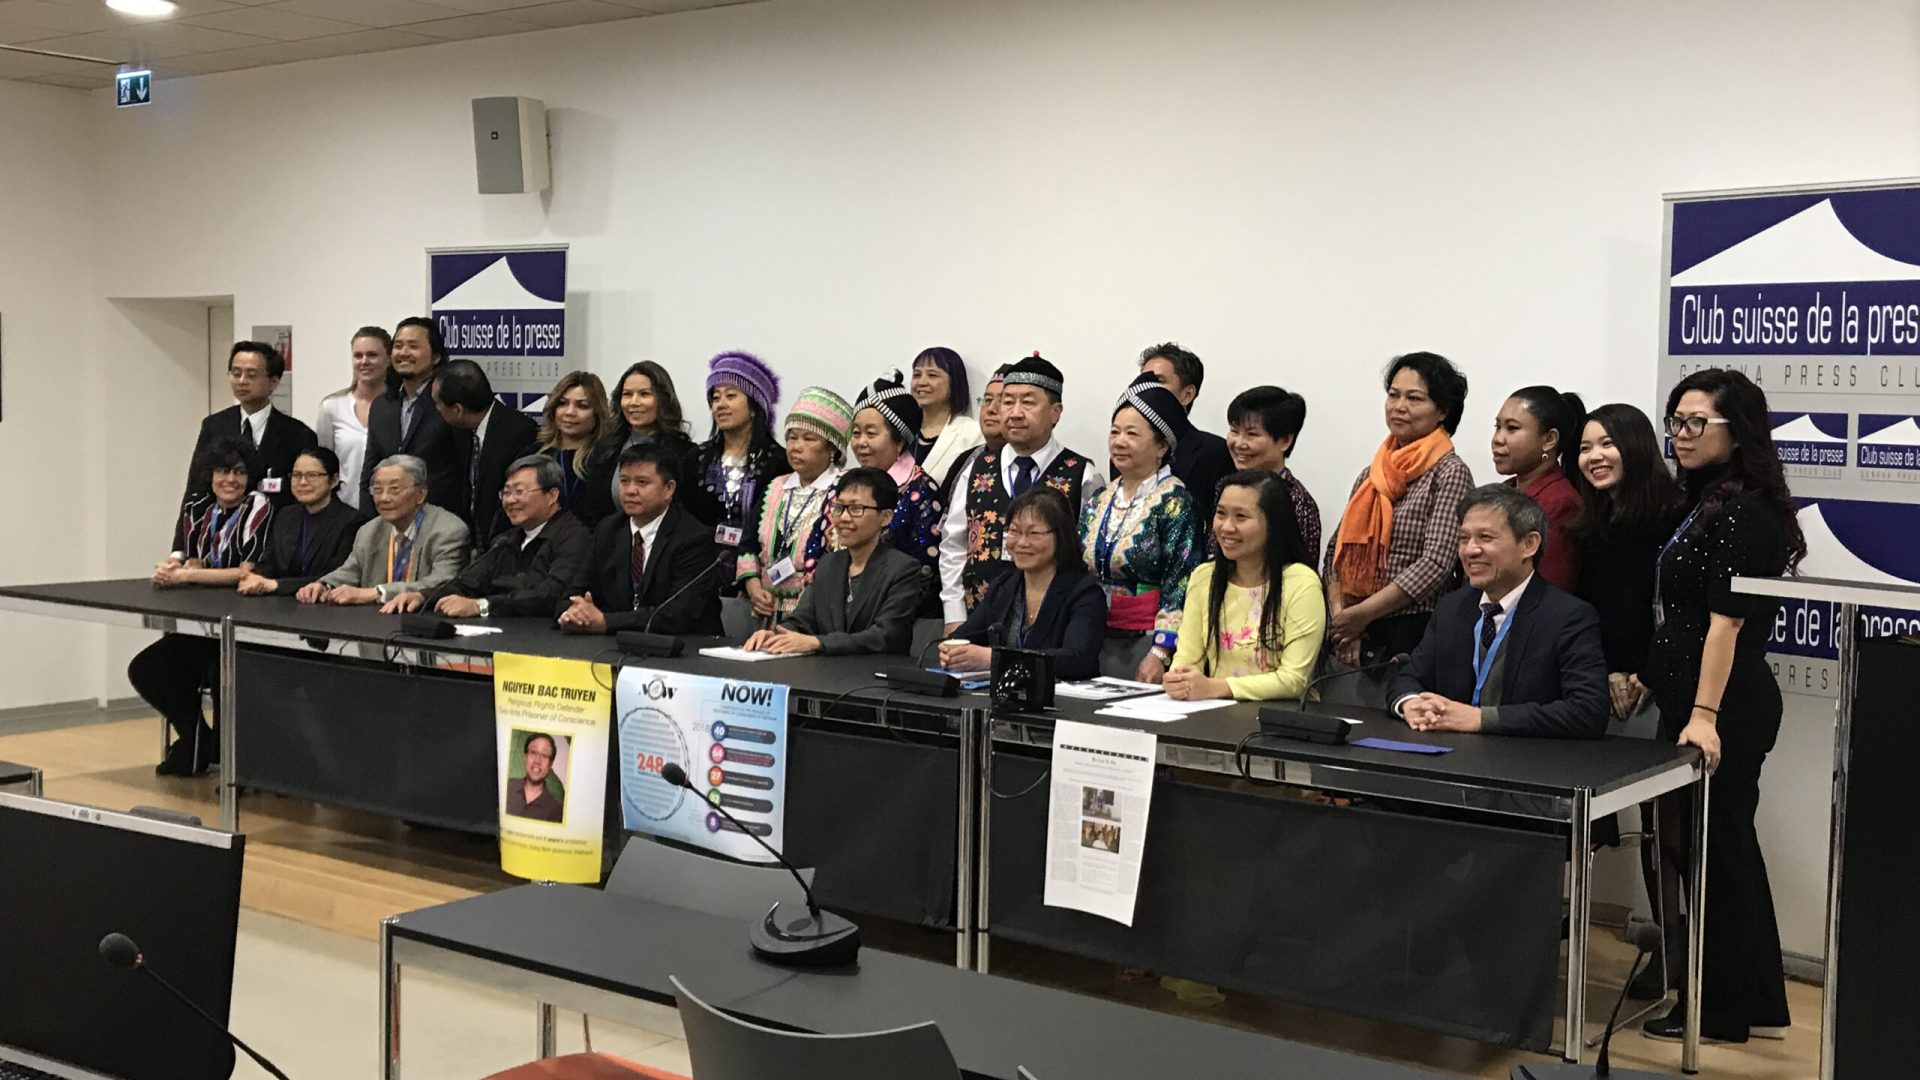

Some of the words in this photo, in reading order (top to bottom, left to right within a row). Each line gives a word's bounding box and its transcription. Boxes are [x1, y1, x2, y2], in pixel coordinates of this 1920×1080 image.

[1681, 294, 1725, 345] Club
[1732, 293, 1799, 345] suisse
[1806, 291, 1832, 344] de
[1841, 291, 1859, 344] la
[439, 315, 459, 349] Club
[461, 315, 494, 349] suisse
[496, 315, 509, 349] de
[512, 315, 521, 349] la
[524, 324, 560, 356] presse
[1784, 365, 1857, 386] PRESS
[1777, 443, 1800, 461] suisse
[1800, 443, 1810, 461] de
[1811, 443, 1818, 461] la
[1819, 449, 1844, 465] presse
[1861, 445, 1878, 464] Club
[1879, 446, 1903, 465] suisse
[1904, 448, 1915, 466] de
[1795, 599, 1820, 647] de
[1773, 663, 1839, 690] PRES
[502, 680, 535, 695] NGUYEN
[537, 685, 558, 698] BAC
[561, 687, 597, 702] TRUYEN
[721, 682, 773, 707] NOW!
[692, 721, 710, 733] 2018
[713, 726, 725, 735] 40
[636, 751, 664, 773] 248
